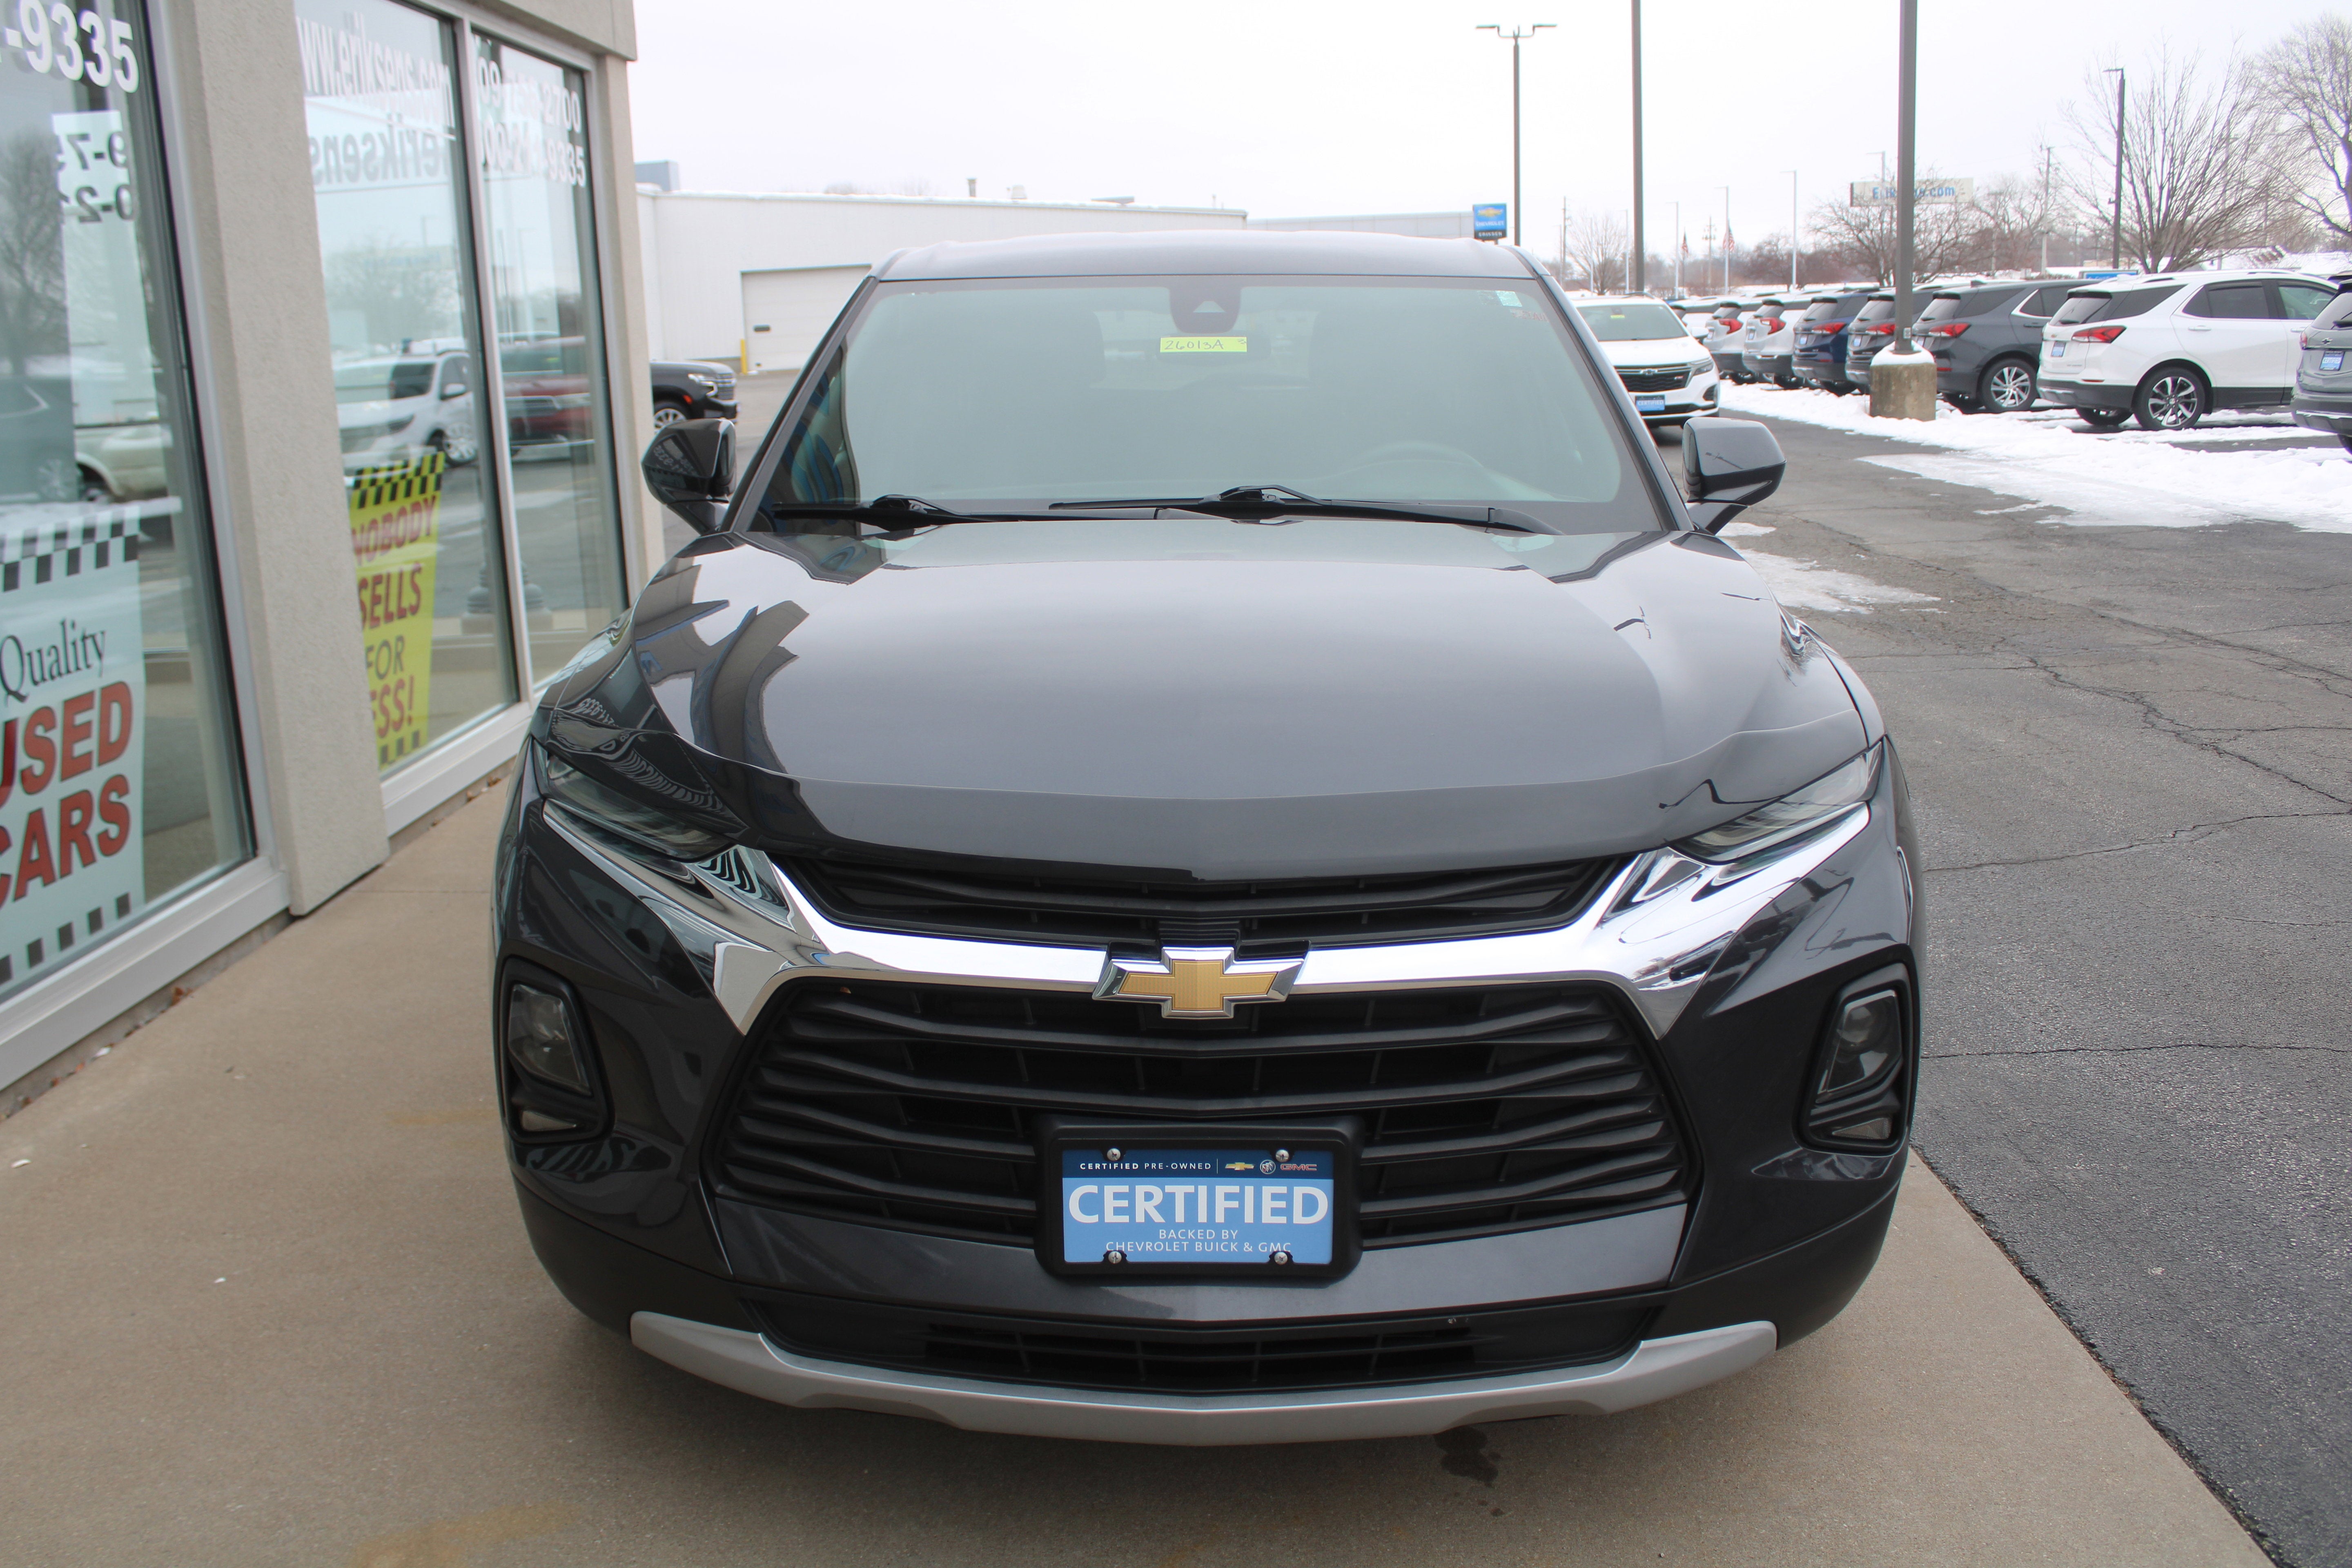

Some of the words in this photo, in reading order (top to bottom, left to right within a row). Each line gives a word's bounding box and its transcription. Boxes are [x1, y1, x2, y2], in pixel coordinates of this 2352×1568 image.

[1164, 339, 1224, 350] 26013A
[352, 494, 437, 567] NOBODY
[359, 562, 422, 631] SELLS
[0, 618, 106, 707] Quality
[1069, 1185, 1328, 1224] CERTIFIED
[1106, 1241, 1189, 1252] CHEVROLET
[1195, 1242, 1238, 1252] BUICK
[1243, 1242, 1253, 1252] &
[1258, 1242, 1291, 1252] GMC
[1159, 1229, 1216, 1239] BACKED
[1222, 1229, 1238, 1239] BY
